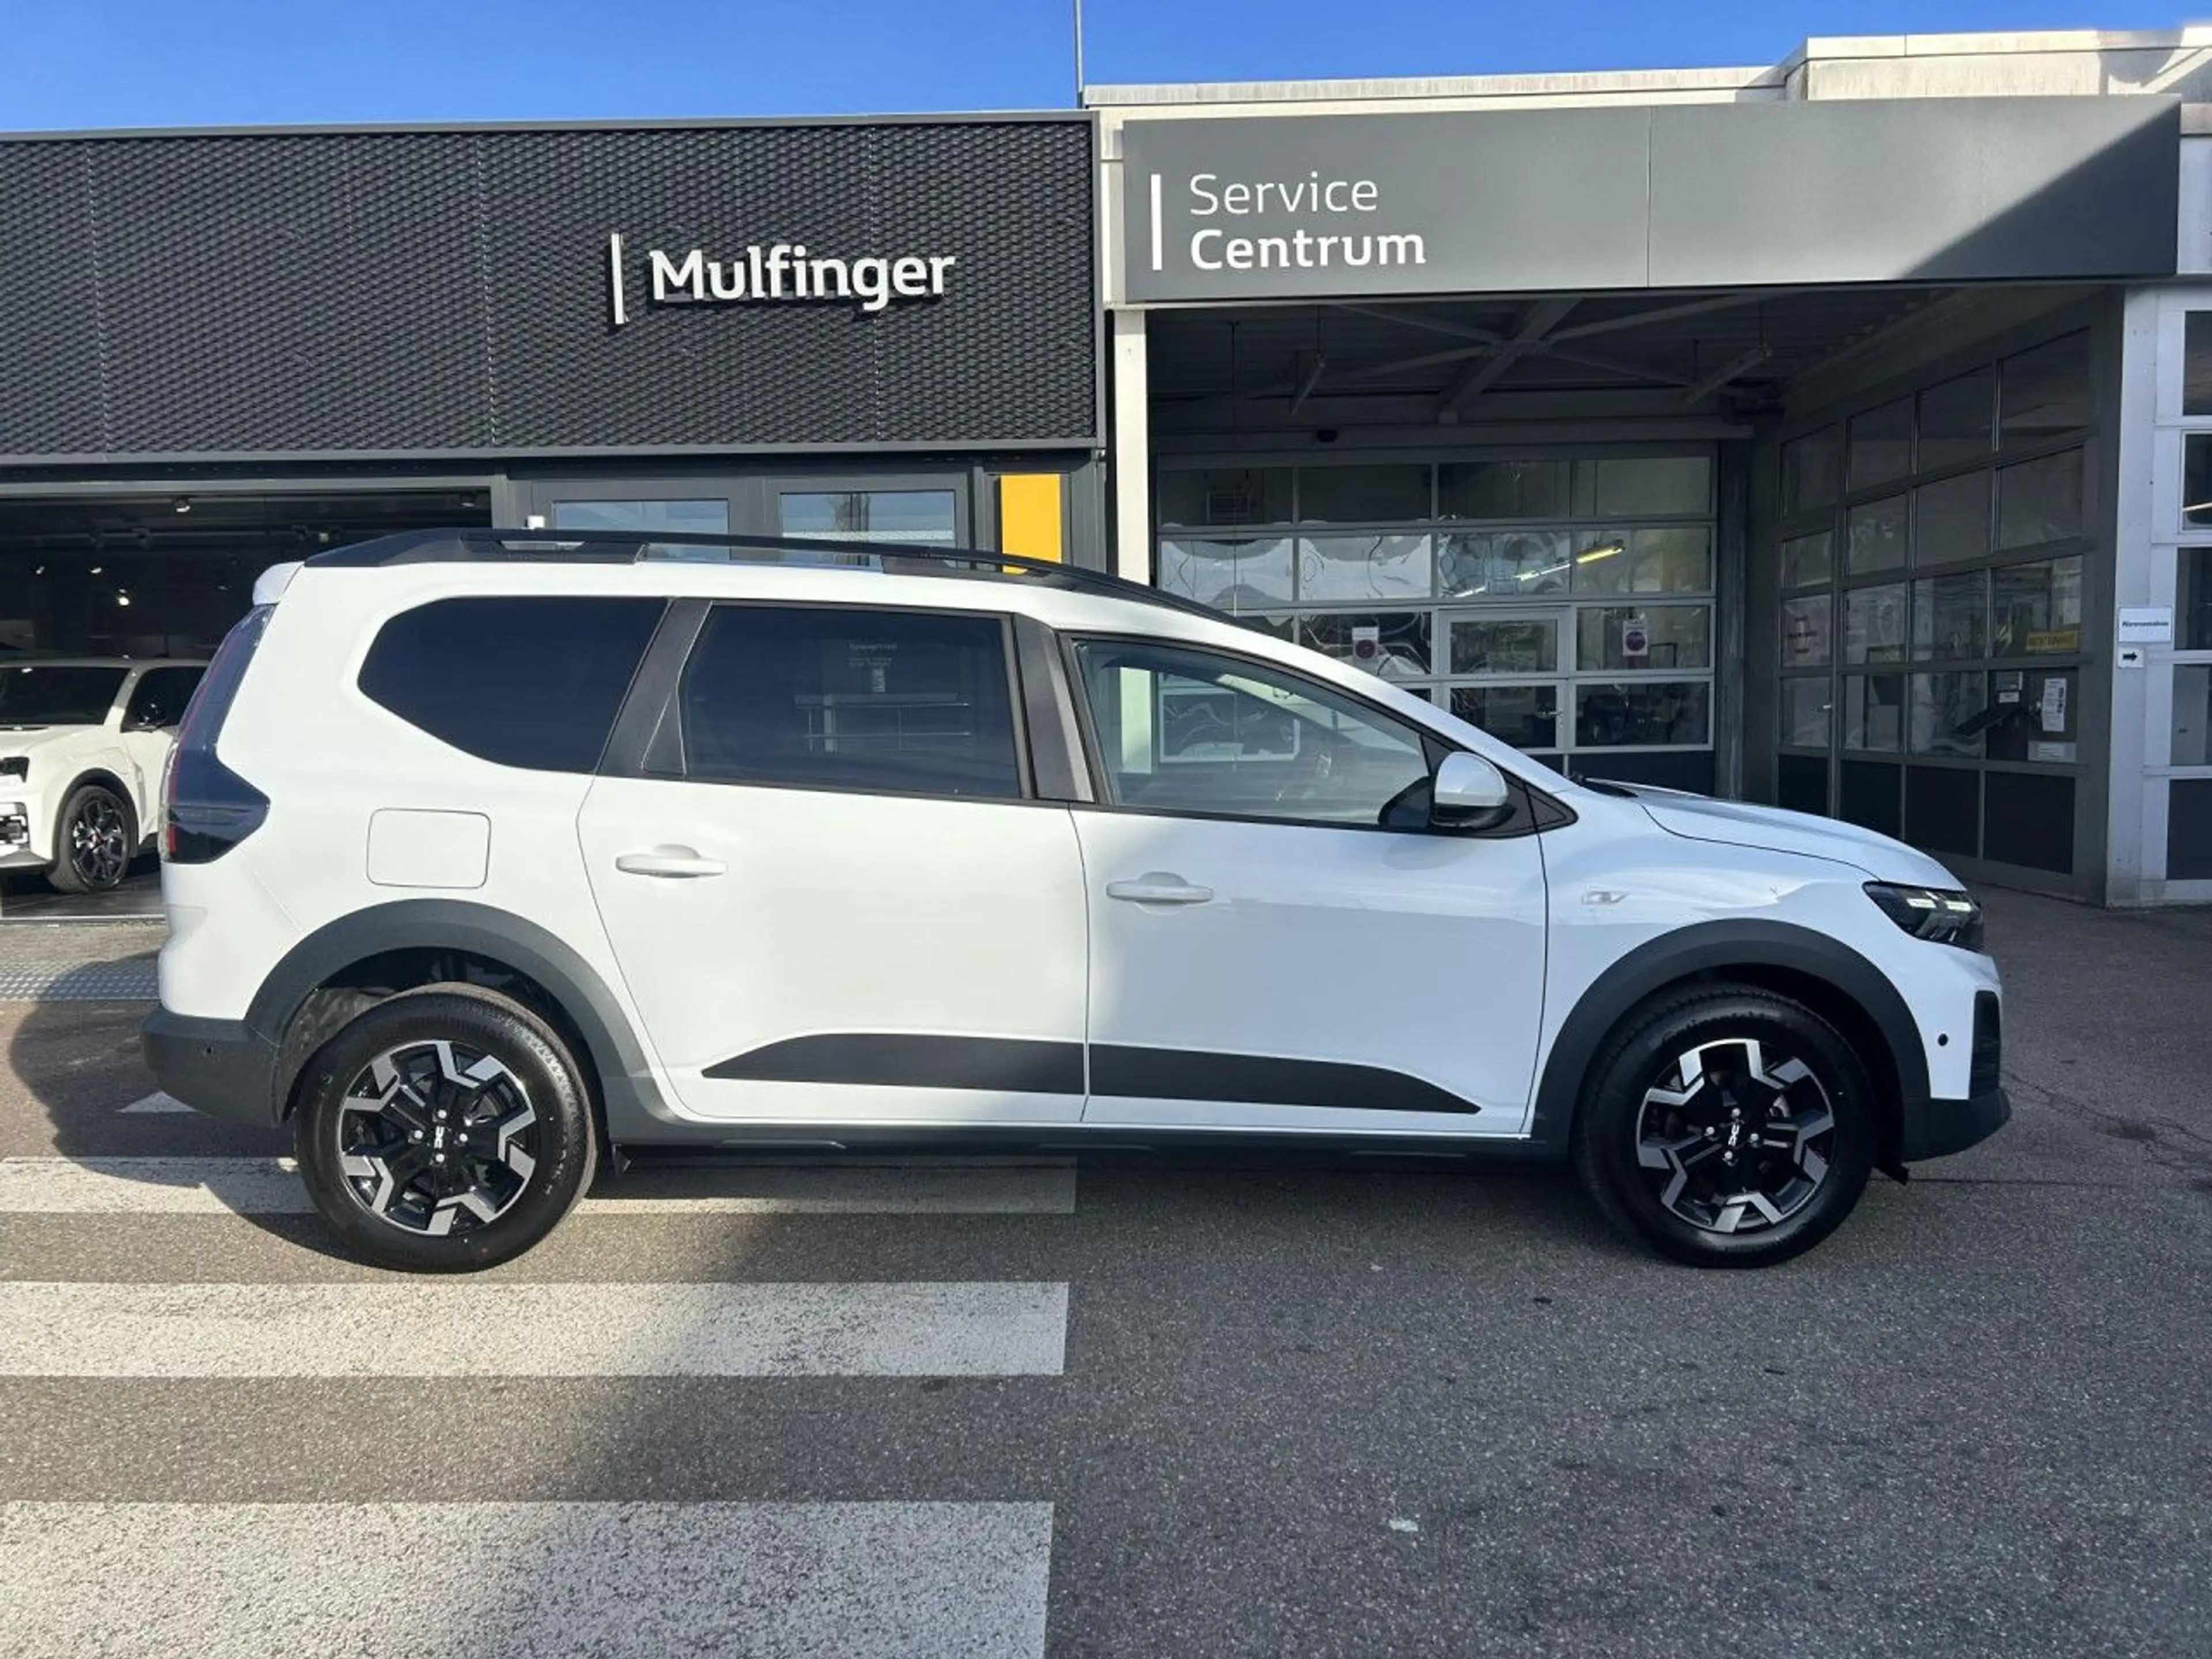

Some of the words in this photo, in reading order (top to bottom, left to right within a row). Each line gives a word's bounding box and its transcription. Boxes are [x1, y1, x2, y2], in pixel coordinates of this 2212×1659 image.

[1190, 171, 1378, 215] Service
[1190, 229, 1427, 270] Centrum
[649, 245, 956, 310] Mulfinger
